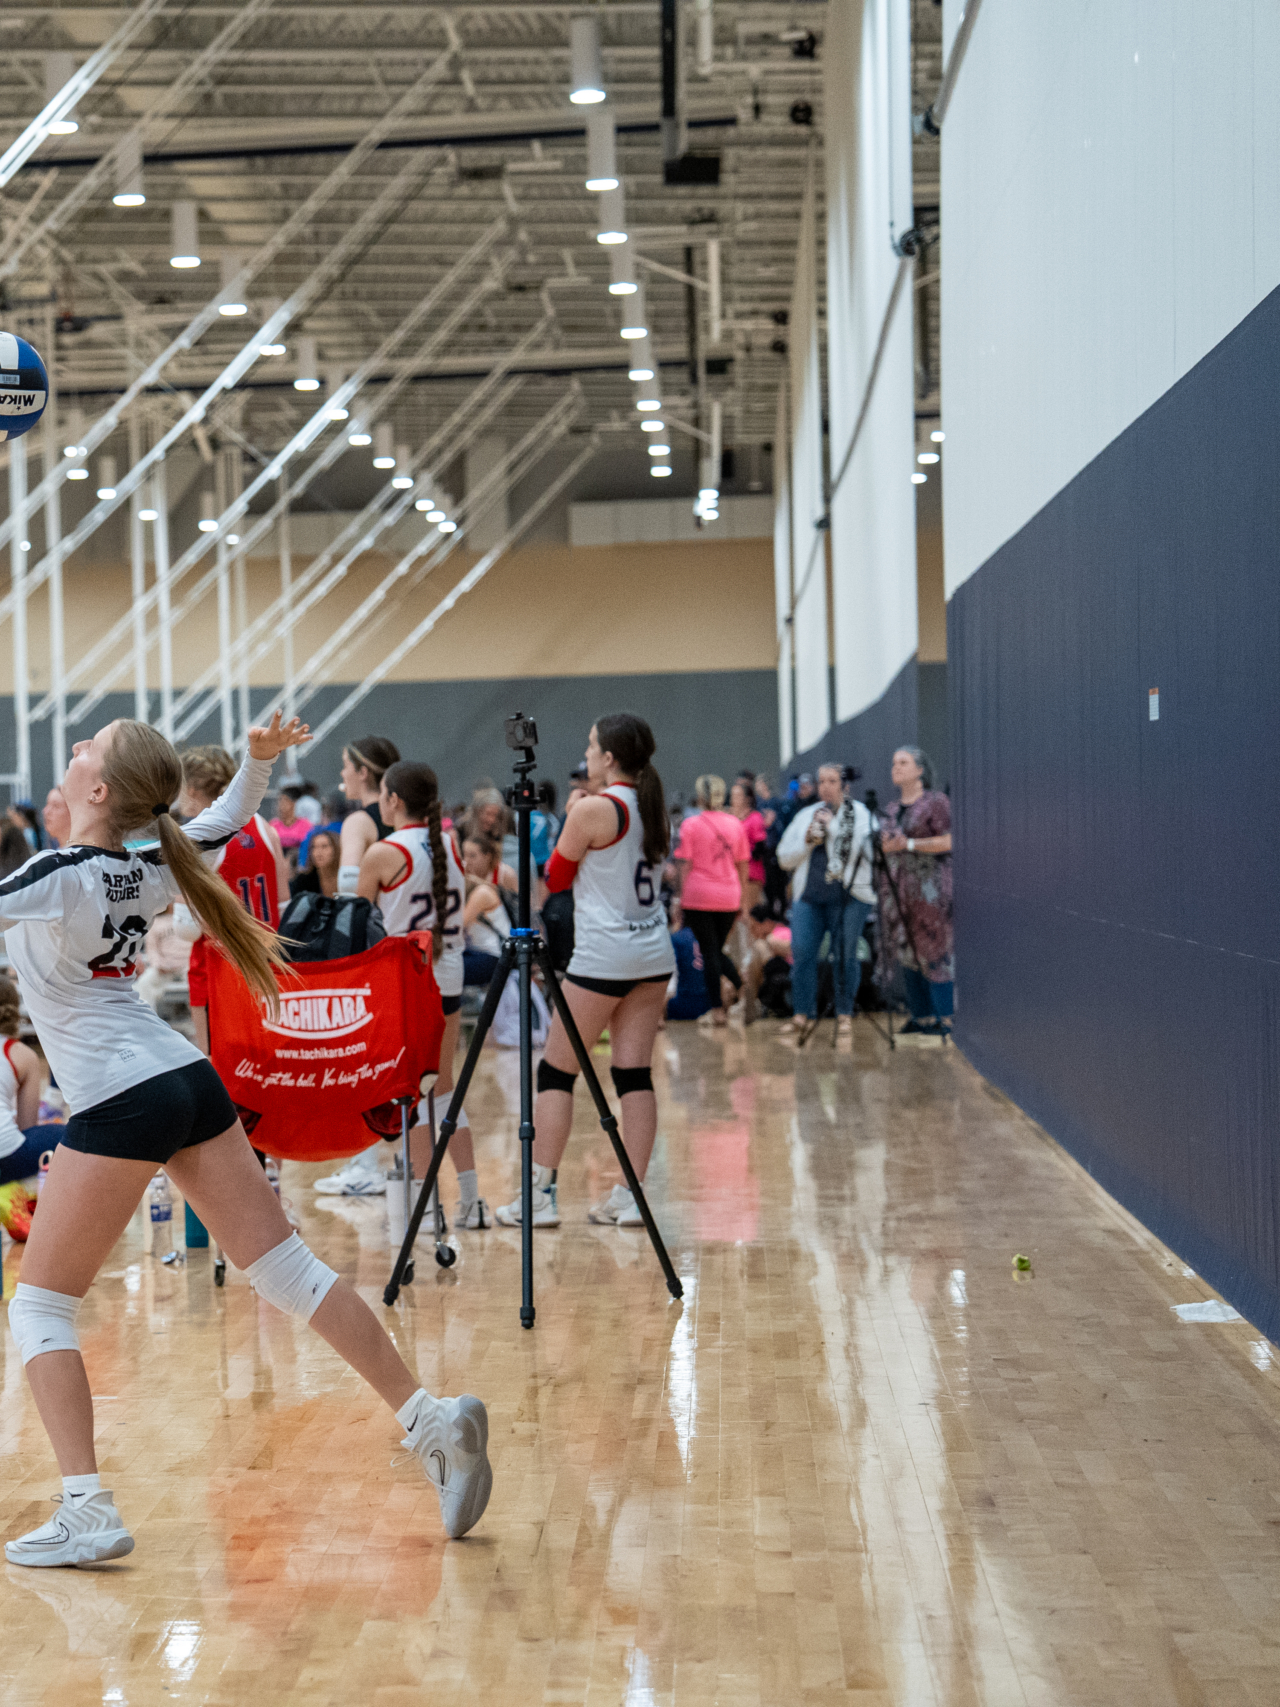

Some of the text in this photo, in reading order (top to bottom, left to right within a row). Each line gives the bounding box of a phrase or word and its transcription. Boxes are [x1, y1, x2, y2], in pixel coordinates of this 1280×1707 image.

[237, 873, 271, 922] 11
[634, 860, 655, 906] 6
[261, 995, 368, 1030] TACHIKARA
[275, 1041, 367, 1060] www.tachikara.com
